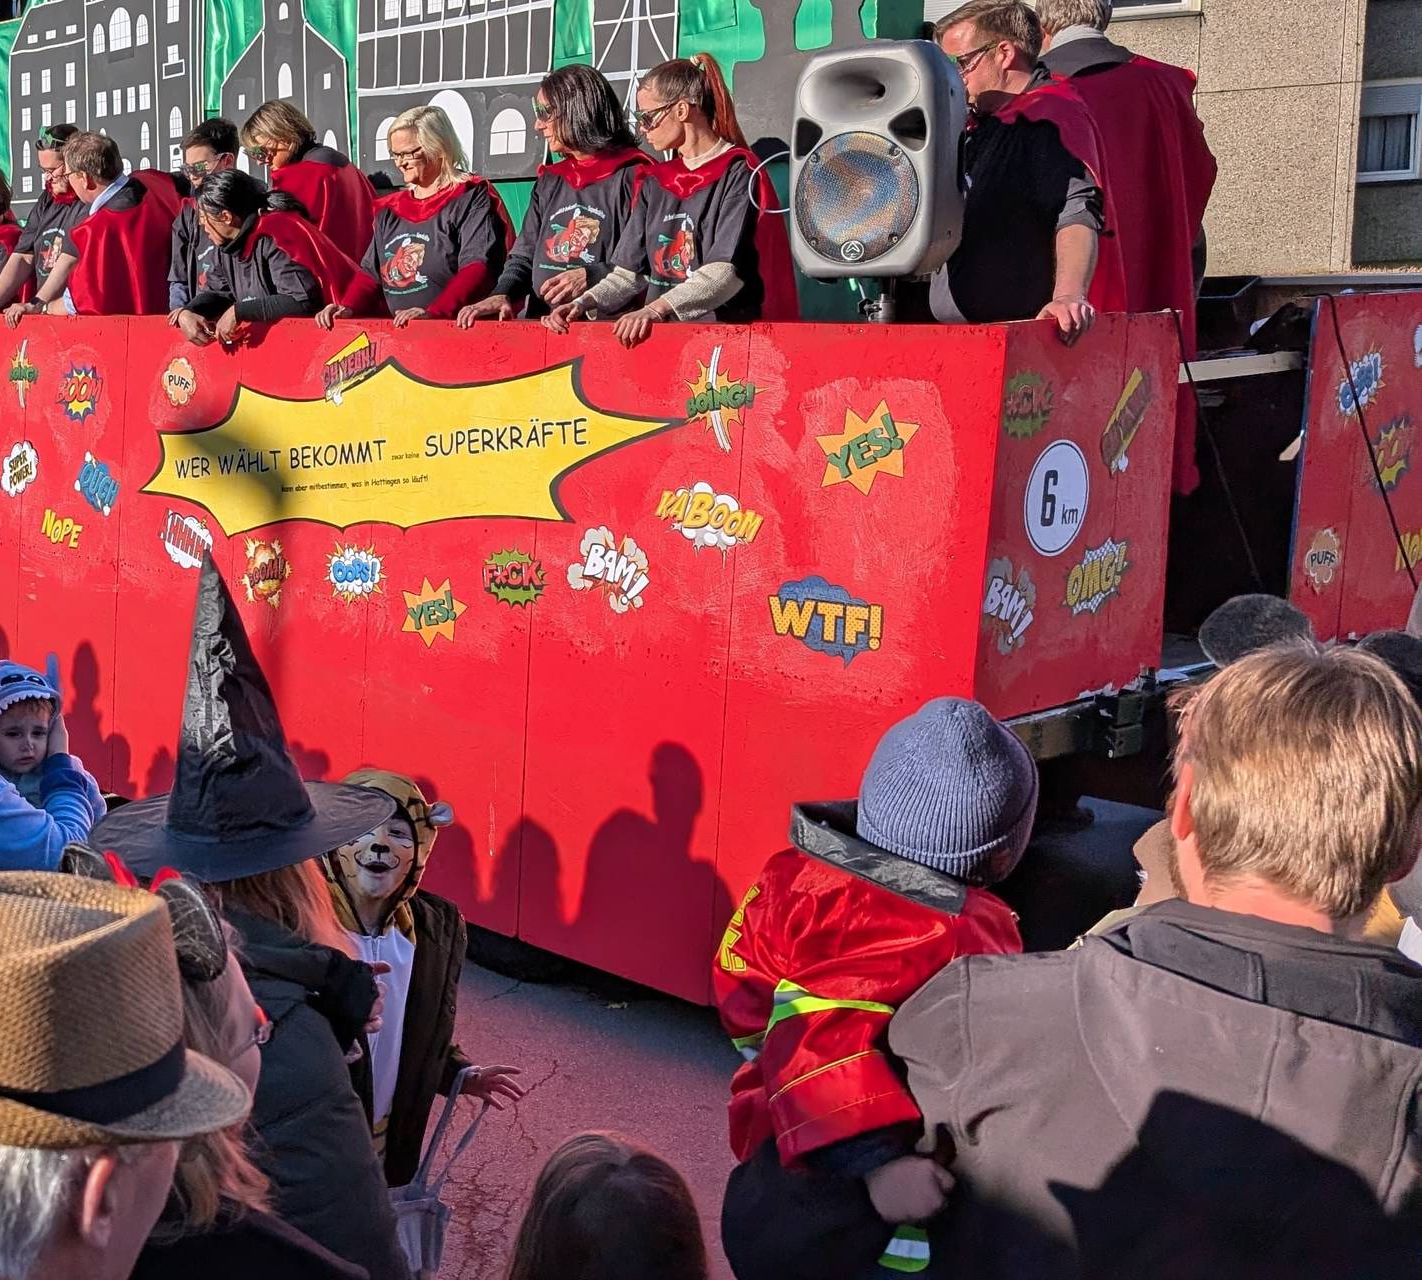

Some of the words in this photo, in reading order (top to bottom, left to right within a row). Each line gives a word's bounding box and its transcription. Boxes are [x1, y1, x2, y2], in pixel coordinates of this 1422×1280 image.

[168, 373, 192, 391] PUFF
[9, 450, 27, 473] SUPER
[174, 456, 211, 479] WER
[217, 448, 281, 475] WÄHLT
[290, 439, 387, 470] BEKOMMT
[827, 412, 904, 479] YES!
[9, 462, 33, 489] POWER!
[655, 490, 764, 544] KABOOM
[1040, 469, 1059, 527] 6
[1061, 503, 1079, 525] km
[41, 508, 83, 548] NOPE
[332, 558, 378, 584] OOPS!
[582, 543, 650, 606] BAM!
[1066, 545, 1127, 607] OMG!
[1310, 550, 1335, 567] PUFF
[408, 589, 457, 630] YES!
[768, 594, 884, 651] WTF!
[983, 576, 1034, 645] BAM!
